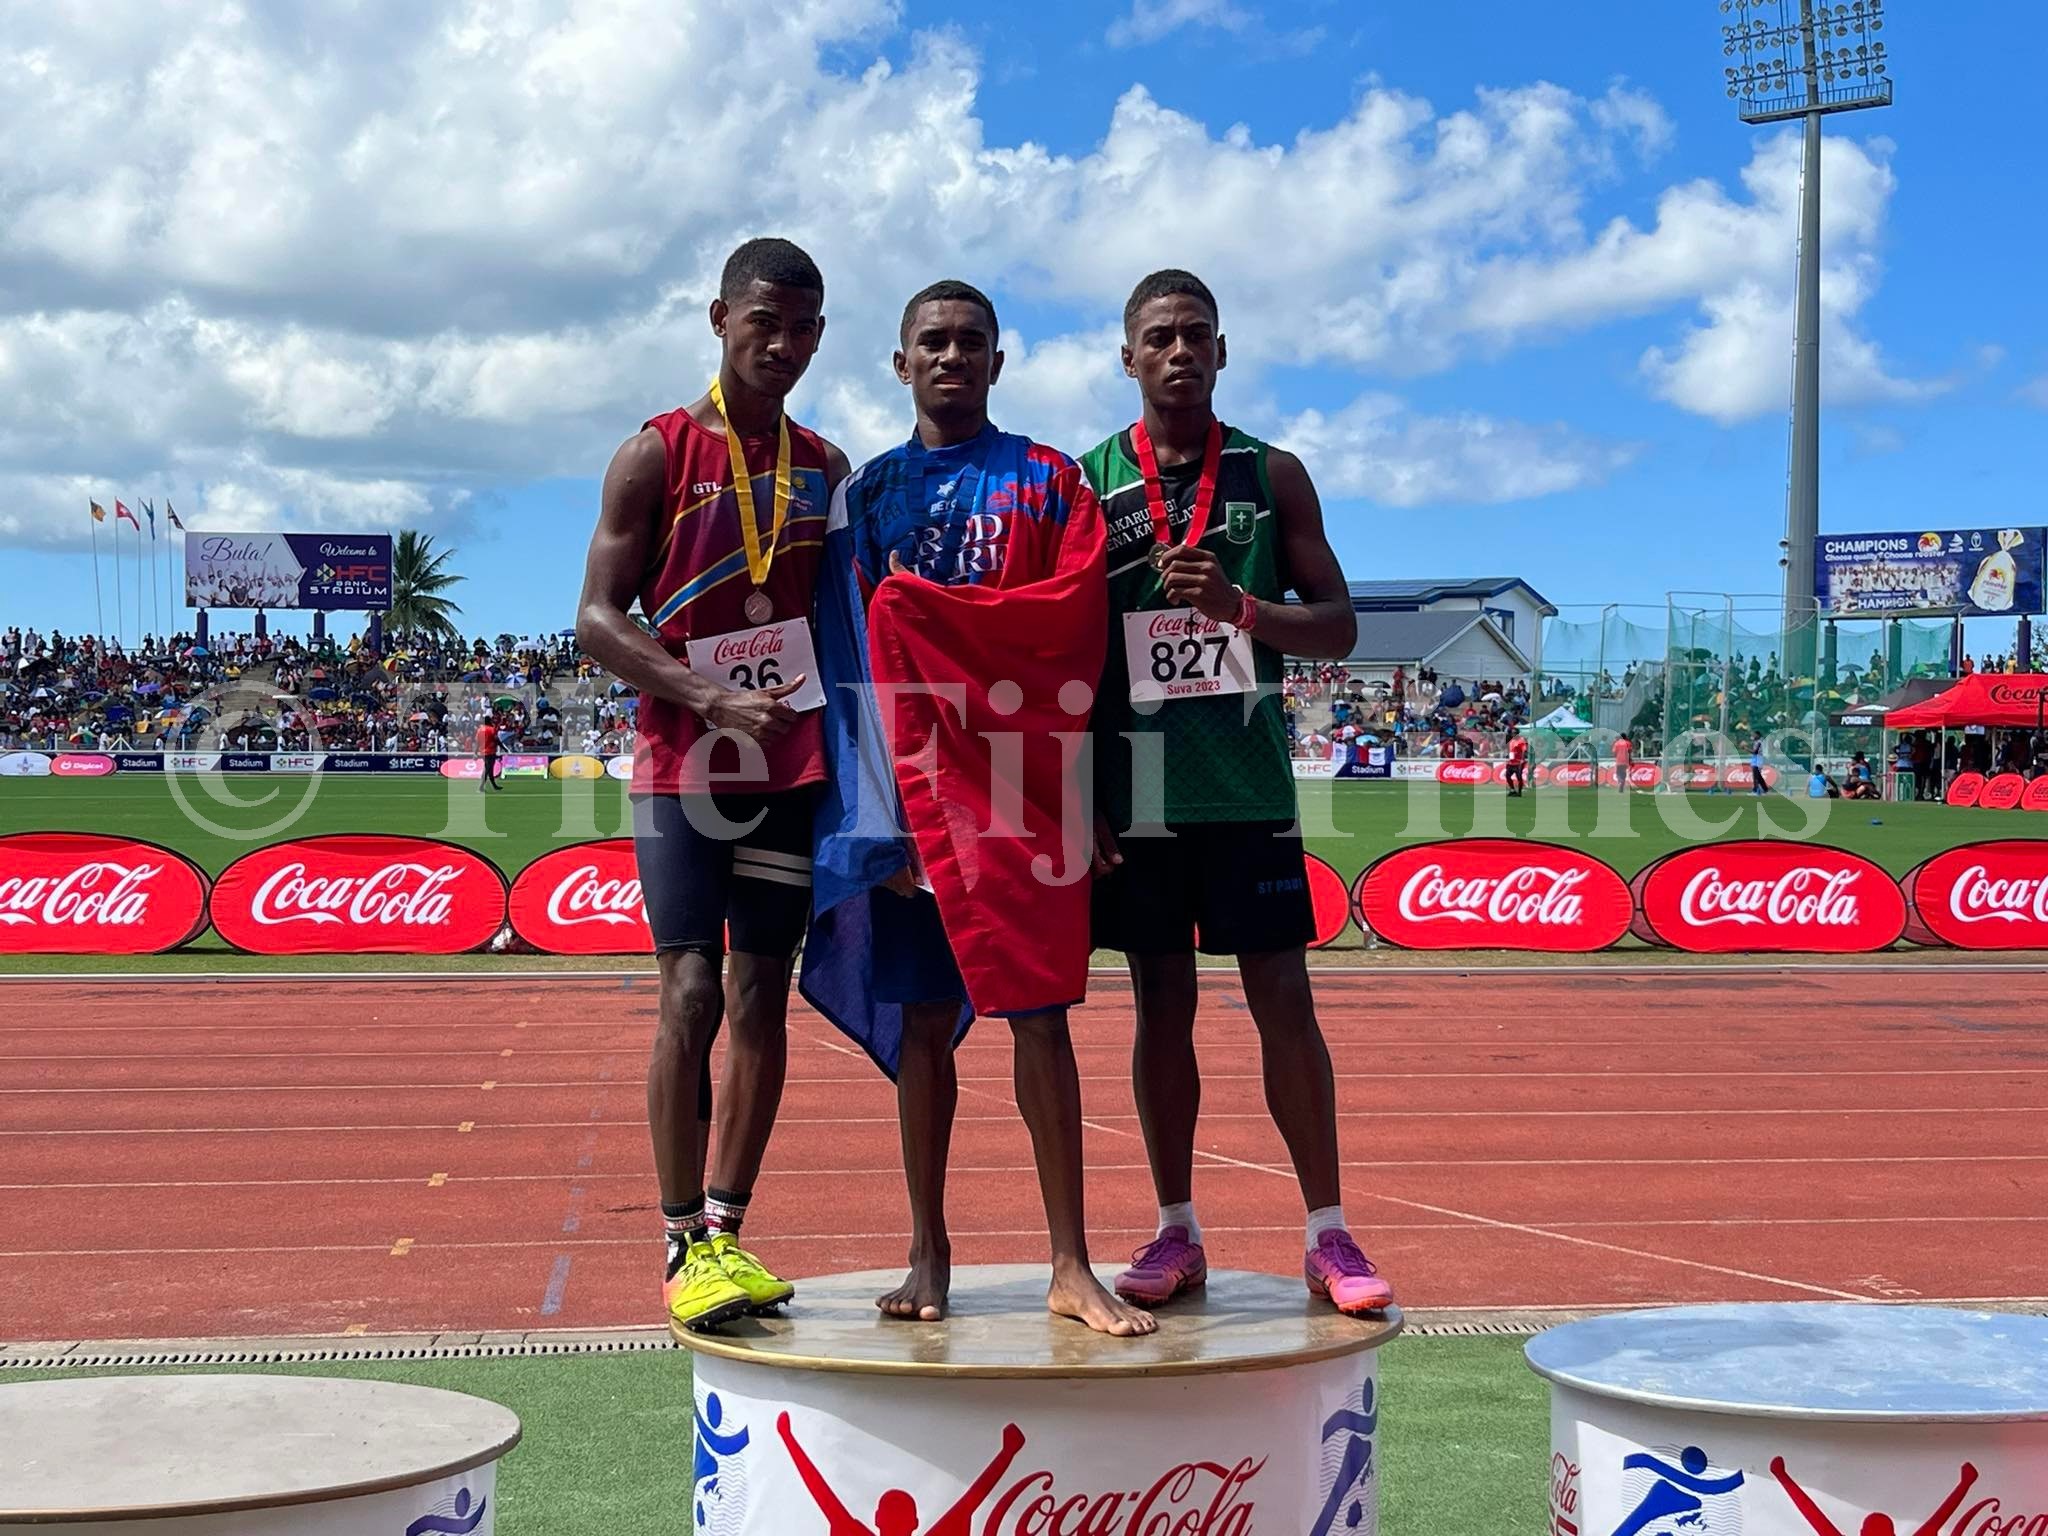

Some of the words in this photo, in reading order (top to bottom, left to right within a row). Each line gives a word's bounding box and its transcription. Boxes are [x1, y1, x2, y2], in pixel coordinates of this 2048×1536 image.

[692, 481, 722, 495] GTL
[200, 537, 273, 561] Bula!
[319, 542, 366, 557] Welcome
[1825, 538, 1908, 553] CHAMPIONS
[1824, 554, 1852, 562] Choose
[1884, 551, 1914, 559] Choose
[336, 565, 386, 582] HFC
[309, 586, 387, 595] STADIUM
[714, 626, 785, 665] Coca-Cola
[1150, 635, 1230, 683] 827
[1167, 683, 1192, 695] Suva
[1195, 680, 1221, 692] 2023
[122, 758, 158, 767] Stadium
[229, 758, 264, 768] Stadium
[334, 759, 369, 768] Stadium
[1351, 765, 1385, 774] Stadium
[0, 862, 165, 925] ca-Cola
[252, 862, 466, 925] Coca-Cola
[547, 864, 651, 926] Coca
[1399, 863, 1590, 926] Coca-Cola
[1680, 867, 1862, 927] Coca-Cola
[983, 1453, 1269, 1536] Coca-Cola
